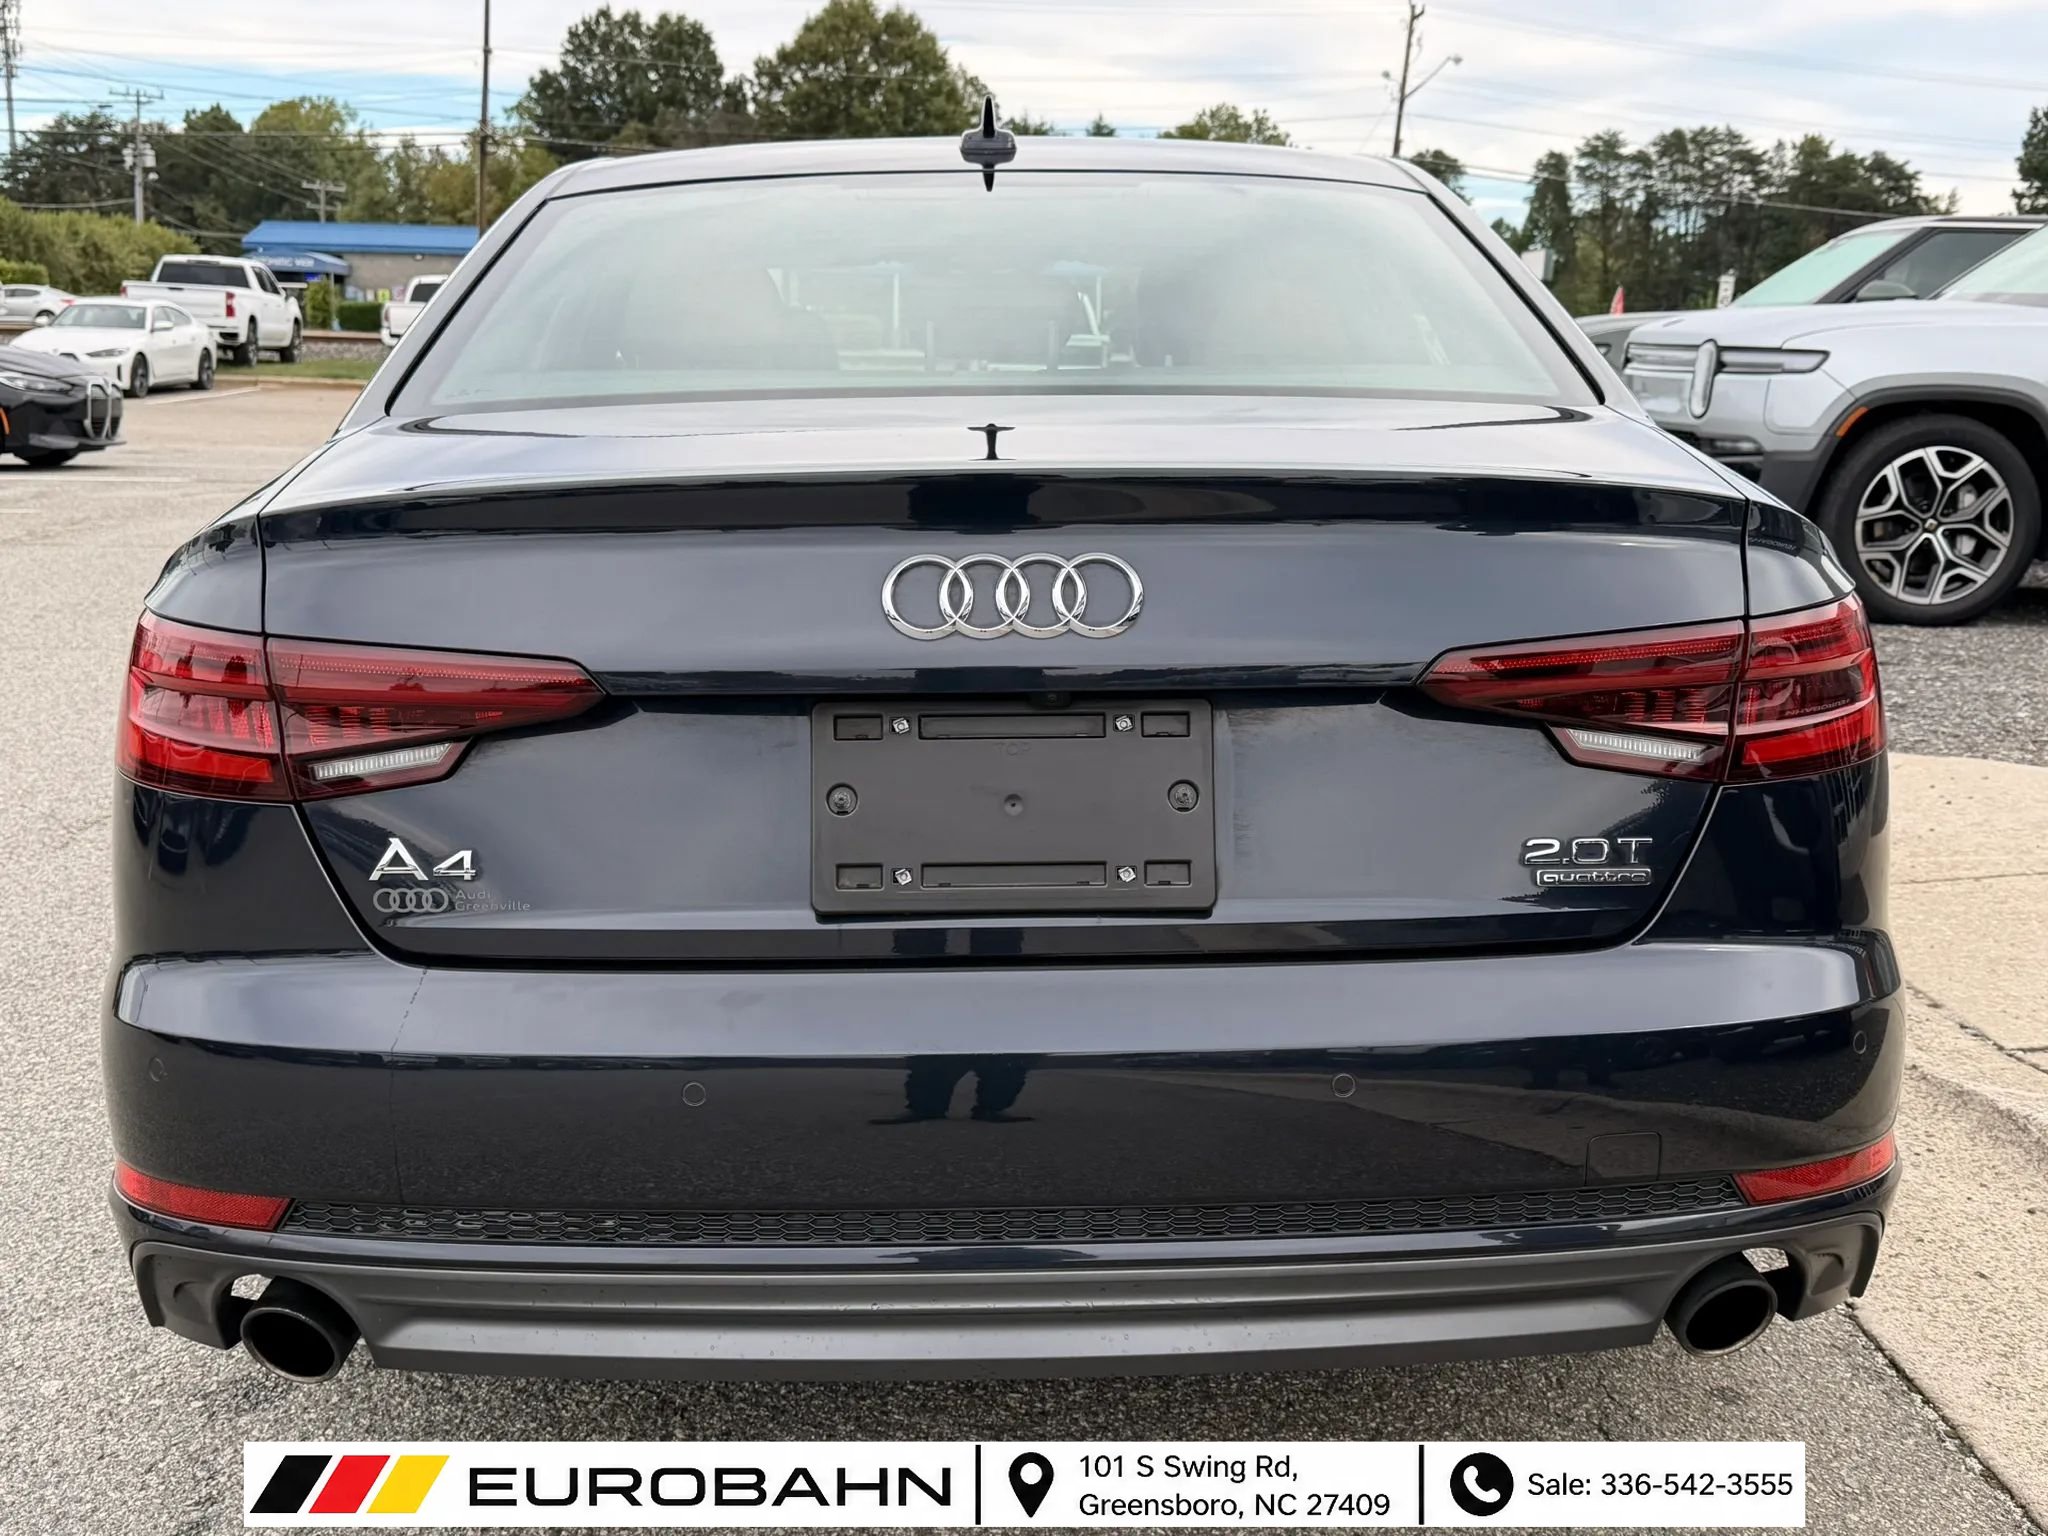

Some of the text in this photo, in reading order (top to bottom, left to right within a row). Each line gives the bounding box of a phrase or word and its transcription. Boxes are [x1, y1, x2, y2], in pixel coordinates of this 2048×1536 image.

[1525, 837, 1653, 865] 2.0T
[368, 837, 477, 881] A4
[1542, 871, 1647, 885] quattro
[455, 889, 492, 900] Audi
[455, 901, 531, 912] Greenville
